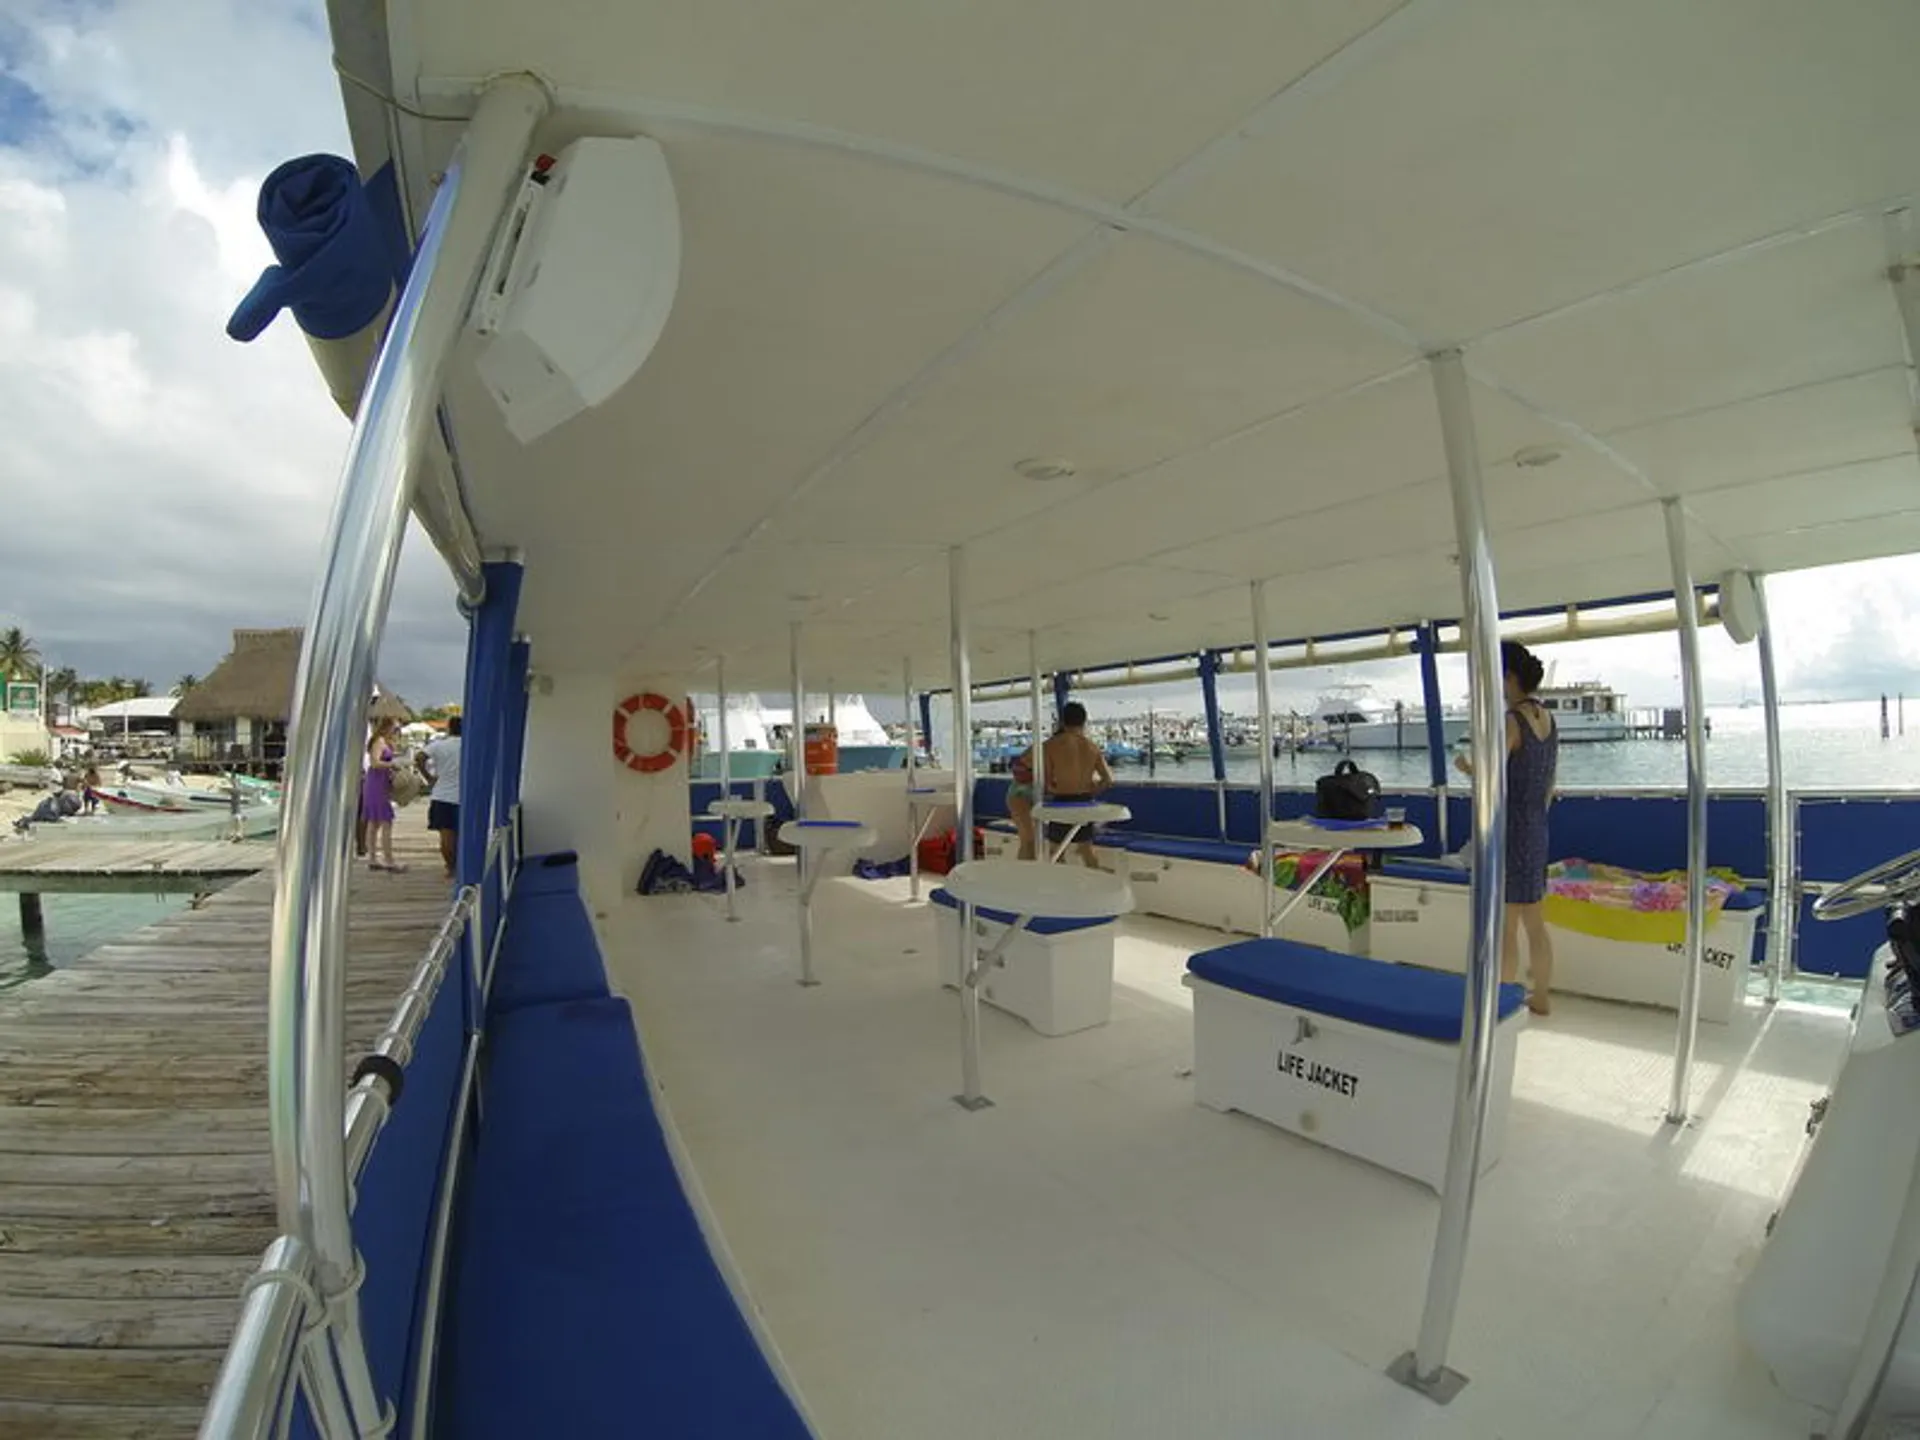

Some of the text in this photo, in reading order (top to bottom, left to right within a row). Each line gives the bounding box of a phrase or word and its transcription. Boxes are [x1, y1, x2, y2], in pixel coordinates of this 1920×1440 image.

[1702, 945, 1735, 970] CKET
[1278, 1050, 1358, 1098] LIFE JACKET
